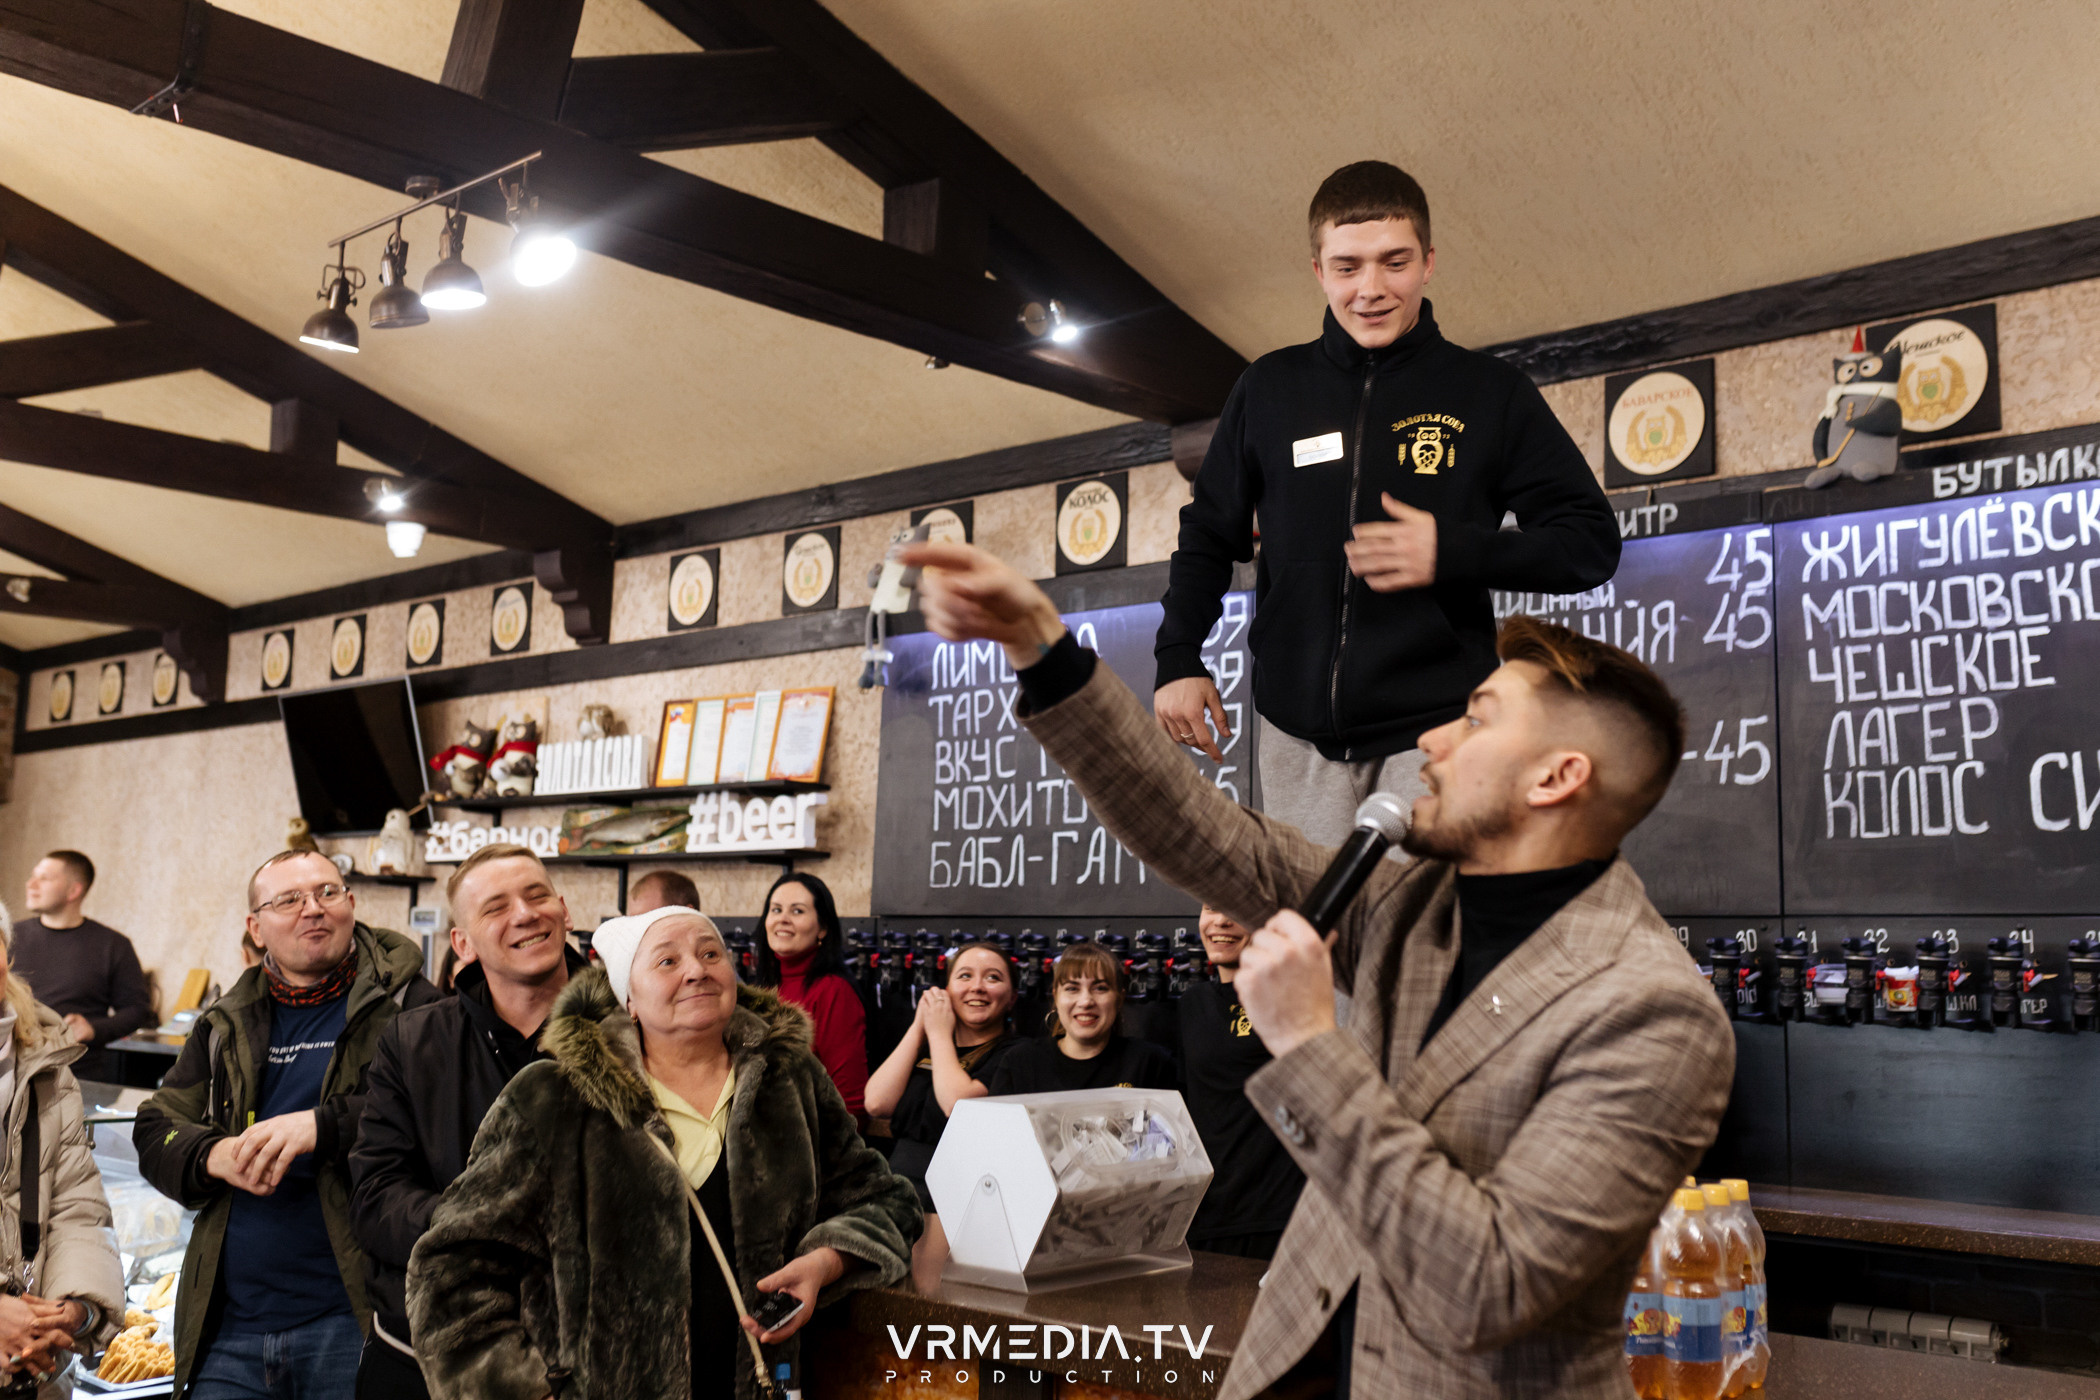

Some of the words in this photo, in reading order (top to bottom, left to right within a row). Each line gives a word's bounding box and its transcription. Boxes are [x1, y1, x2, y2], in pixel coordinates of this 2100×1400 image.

[1391, 413, 1441, 432] ЗОЛОТАЯ
[1441, 414, 1465, 433] СОВА
[1932, 441, 2100, 499] БУТЫЛК
[1614, 502, 1678, 539] ИТР
[1705, 527, 1773, 592] 45
[1703, 588, 1773, 652] 45
[1807, 625, 2056, 703] ЧЕШСКОЕ
[934, 735, 1017, 784] ВКУС
[1823, 696, 1999, 770] ЛАГЕР
[686, 790, 820, 846] #beer
[932, 779, 1089, 832] МОХИТО
[1824, 760, 1990, 839] КОЛОС
[1735, 928, 1758, 953] 30
